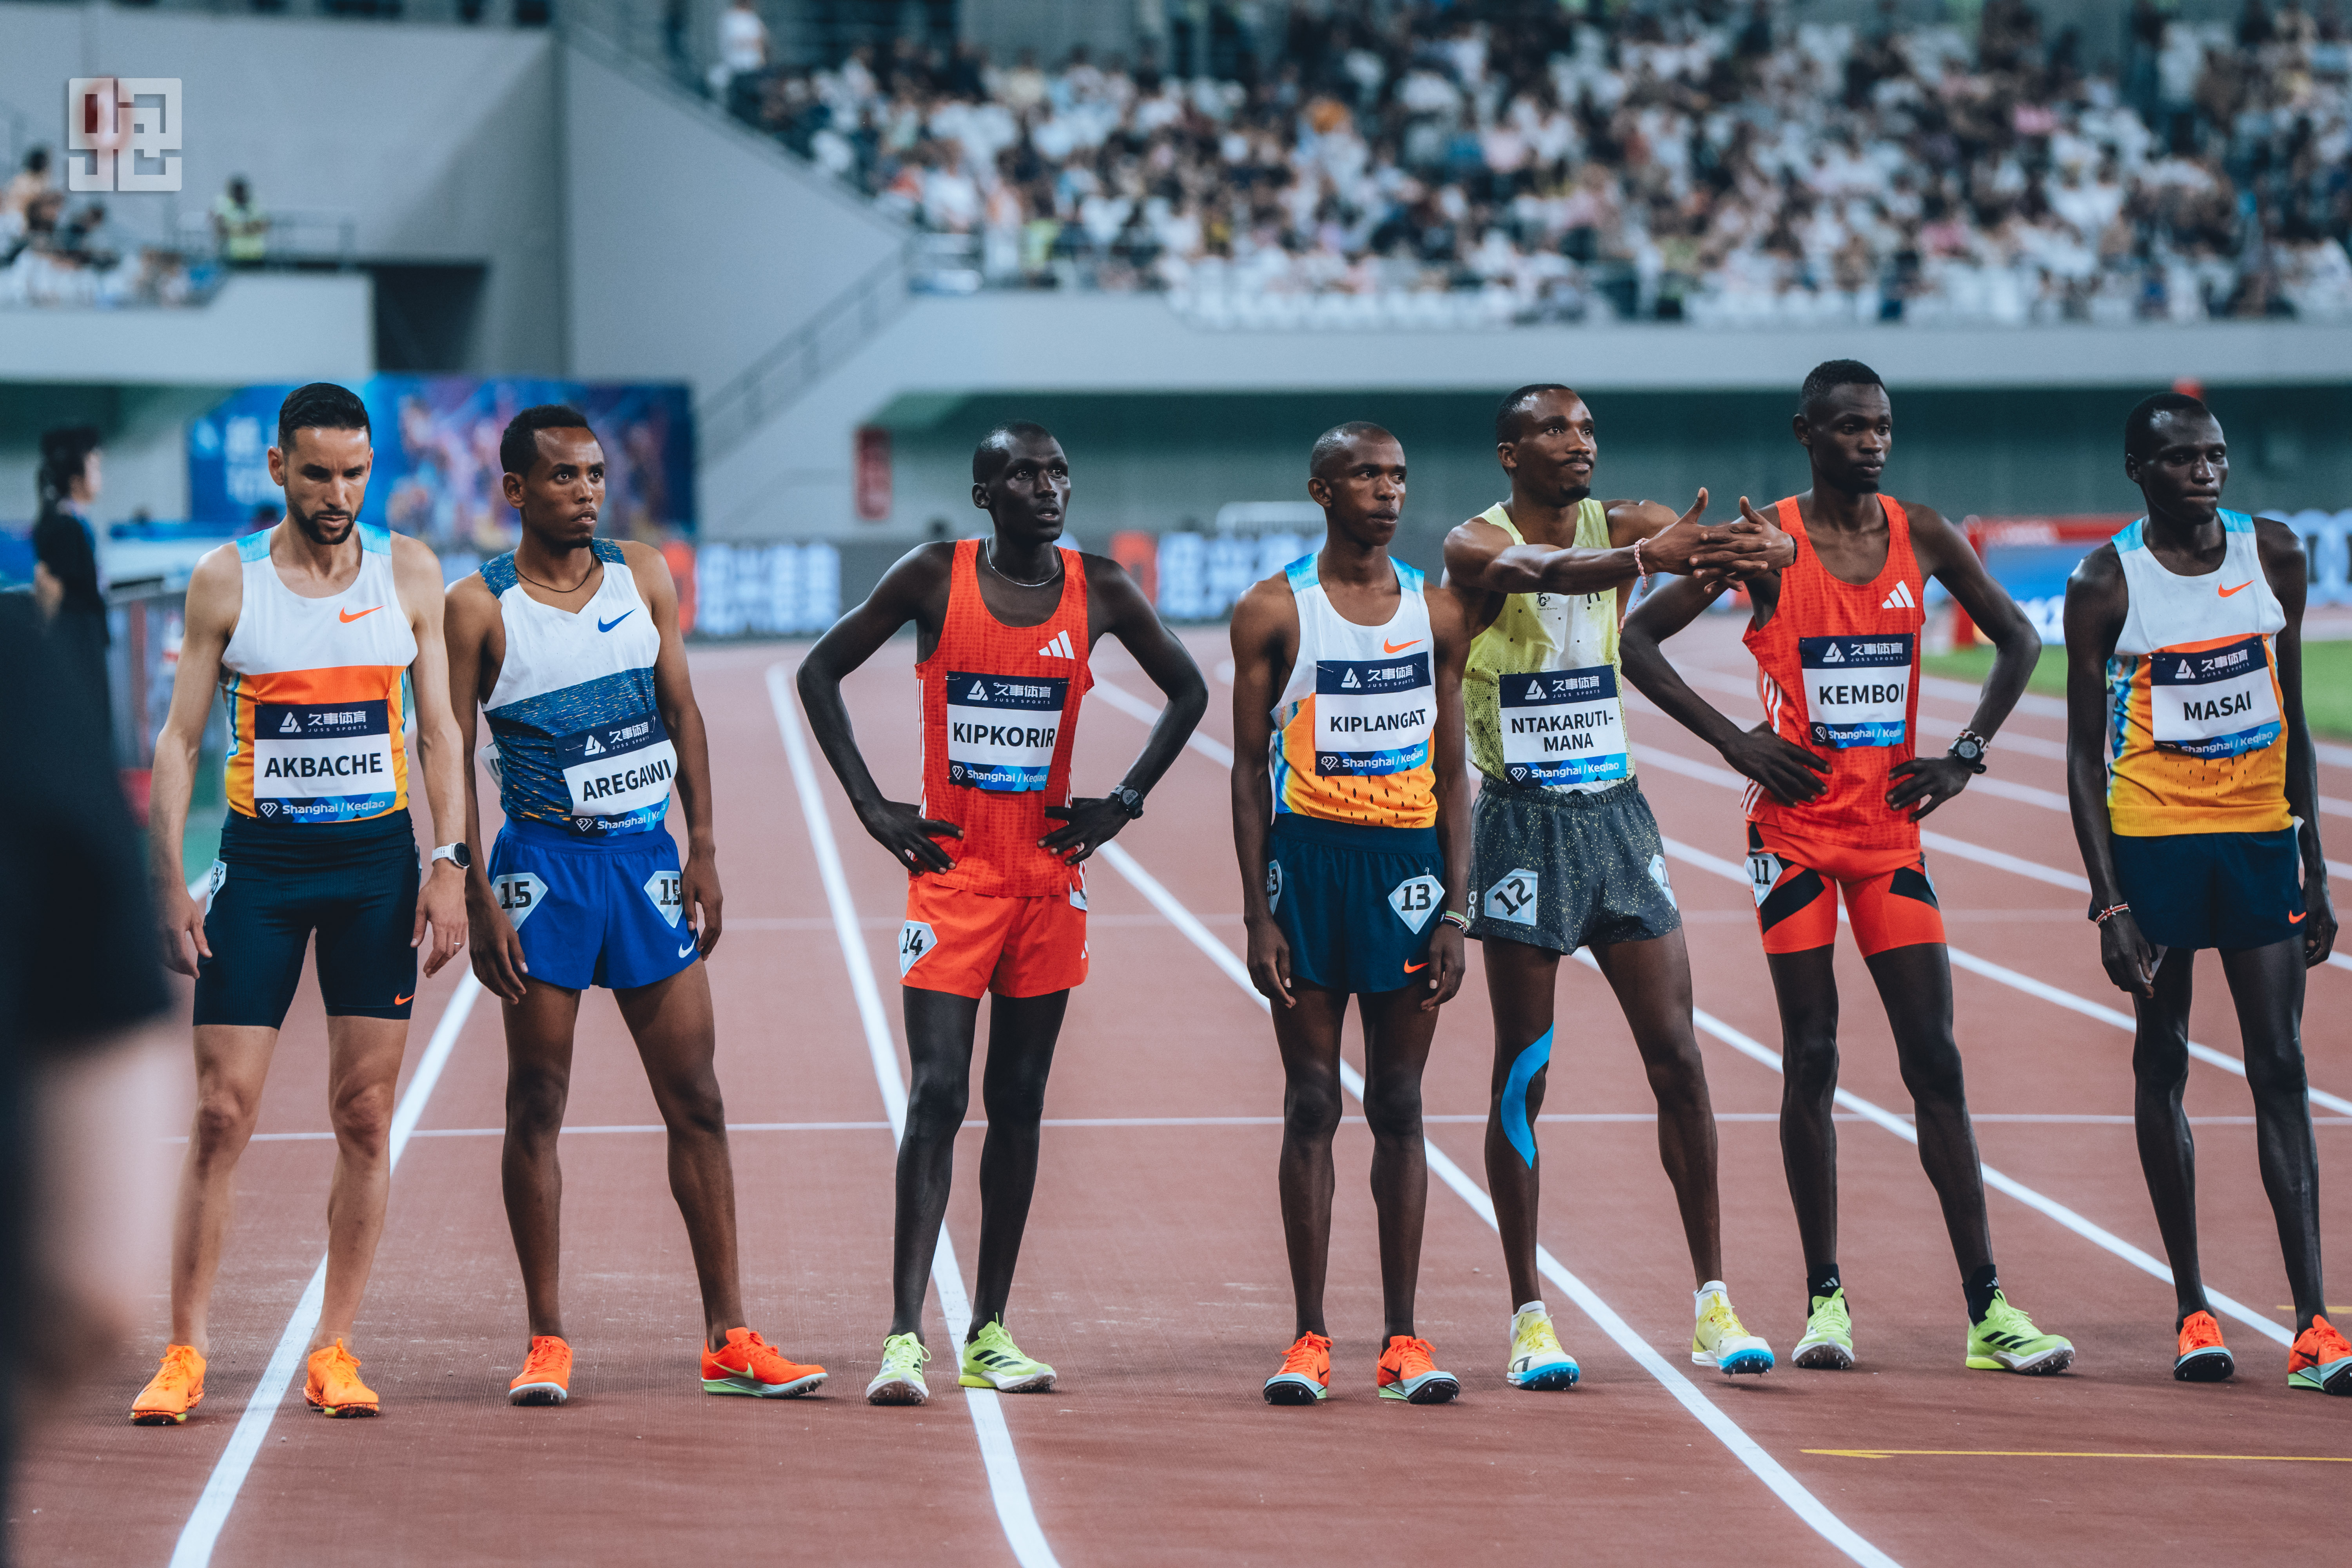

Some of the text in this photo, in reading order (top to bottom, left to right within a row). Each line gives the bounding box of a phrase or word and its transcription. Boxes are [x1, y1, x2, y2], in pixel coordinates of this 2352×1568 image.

[1850, 643, 1903, 656] 久事体育
[2201, 649, 2248, 672] 久事体育
[1368, 665, 1413, 681] 久事体育
[1552, 676, 1599, 692] 久事体育
[994, 684, 1051, 698] 久事体育
[1819, 684, 1904, 705] KEMBOI
[2183, 691, 2252, 721] MASAI
[308, 711, 367, 726] 久事体育
[1330, 709, 1426, 732] KIPLANGAT
[1512, 710, 1614, 733] NTAKARUTI-
[609, 722, 649, 744] 久事体育
[953, 722, 1055, 748] KIPKORIR
[1543, 733, 1594, 752] MANA
[1828, 729, 1875, 740] Shanghai
[2181, 740, 2233, 753] Shanghai
[2240, 731, 2273, 746] Keqiao
[264, 753, 383, 778] AKBACHE
[1343, 757, 1395, 768] Shanghai
[1532, 766, 1582, 779] Shanghai
[1588, 762, 1619, 773] Keqiao
[584, 759, 671, 802] AREGAWI
[967, 770, 1015, 782] Shanghai
[282, 804, 338, 815] Shanghai
[347, 800, 385, 811] Keqiao
[597, 815, 646, 829] Shanghai
[1753, 859, 1770, 885] 11
[501, 881, 532, 909] 15
[660, 879, 681, 905] 15
[1401, 884, 1431, 911] 13
[1494, 878, 1534, 916] 12
[902, 928, 923, 956] 14
